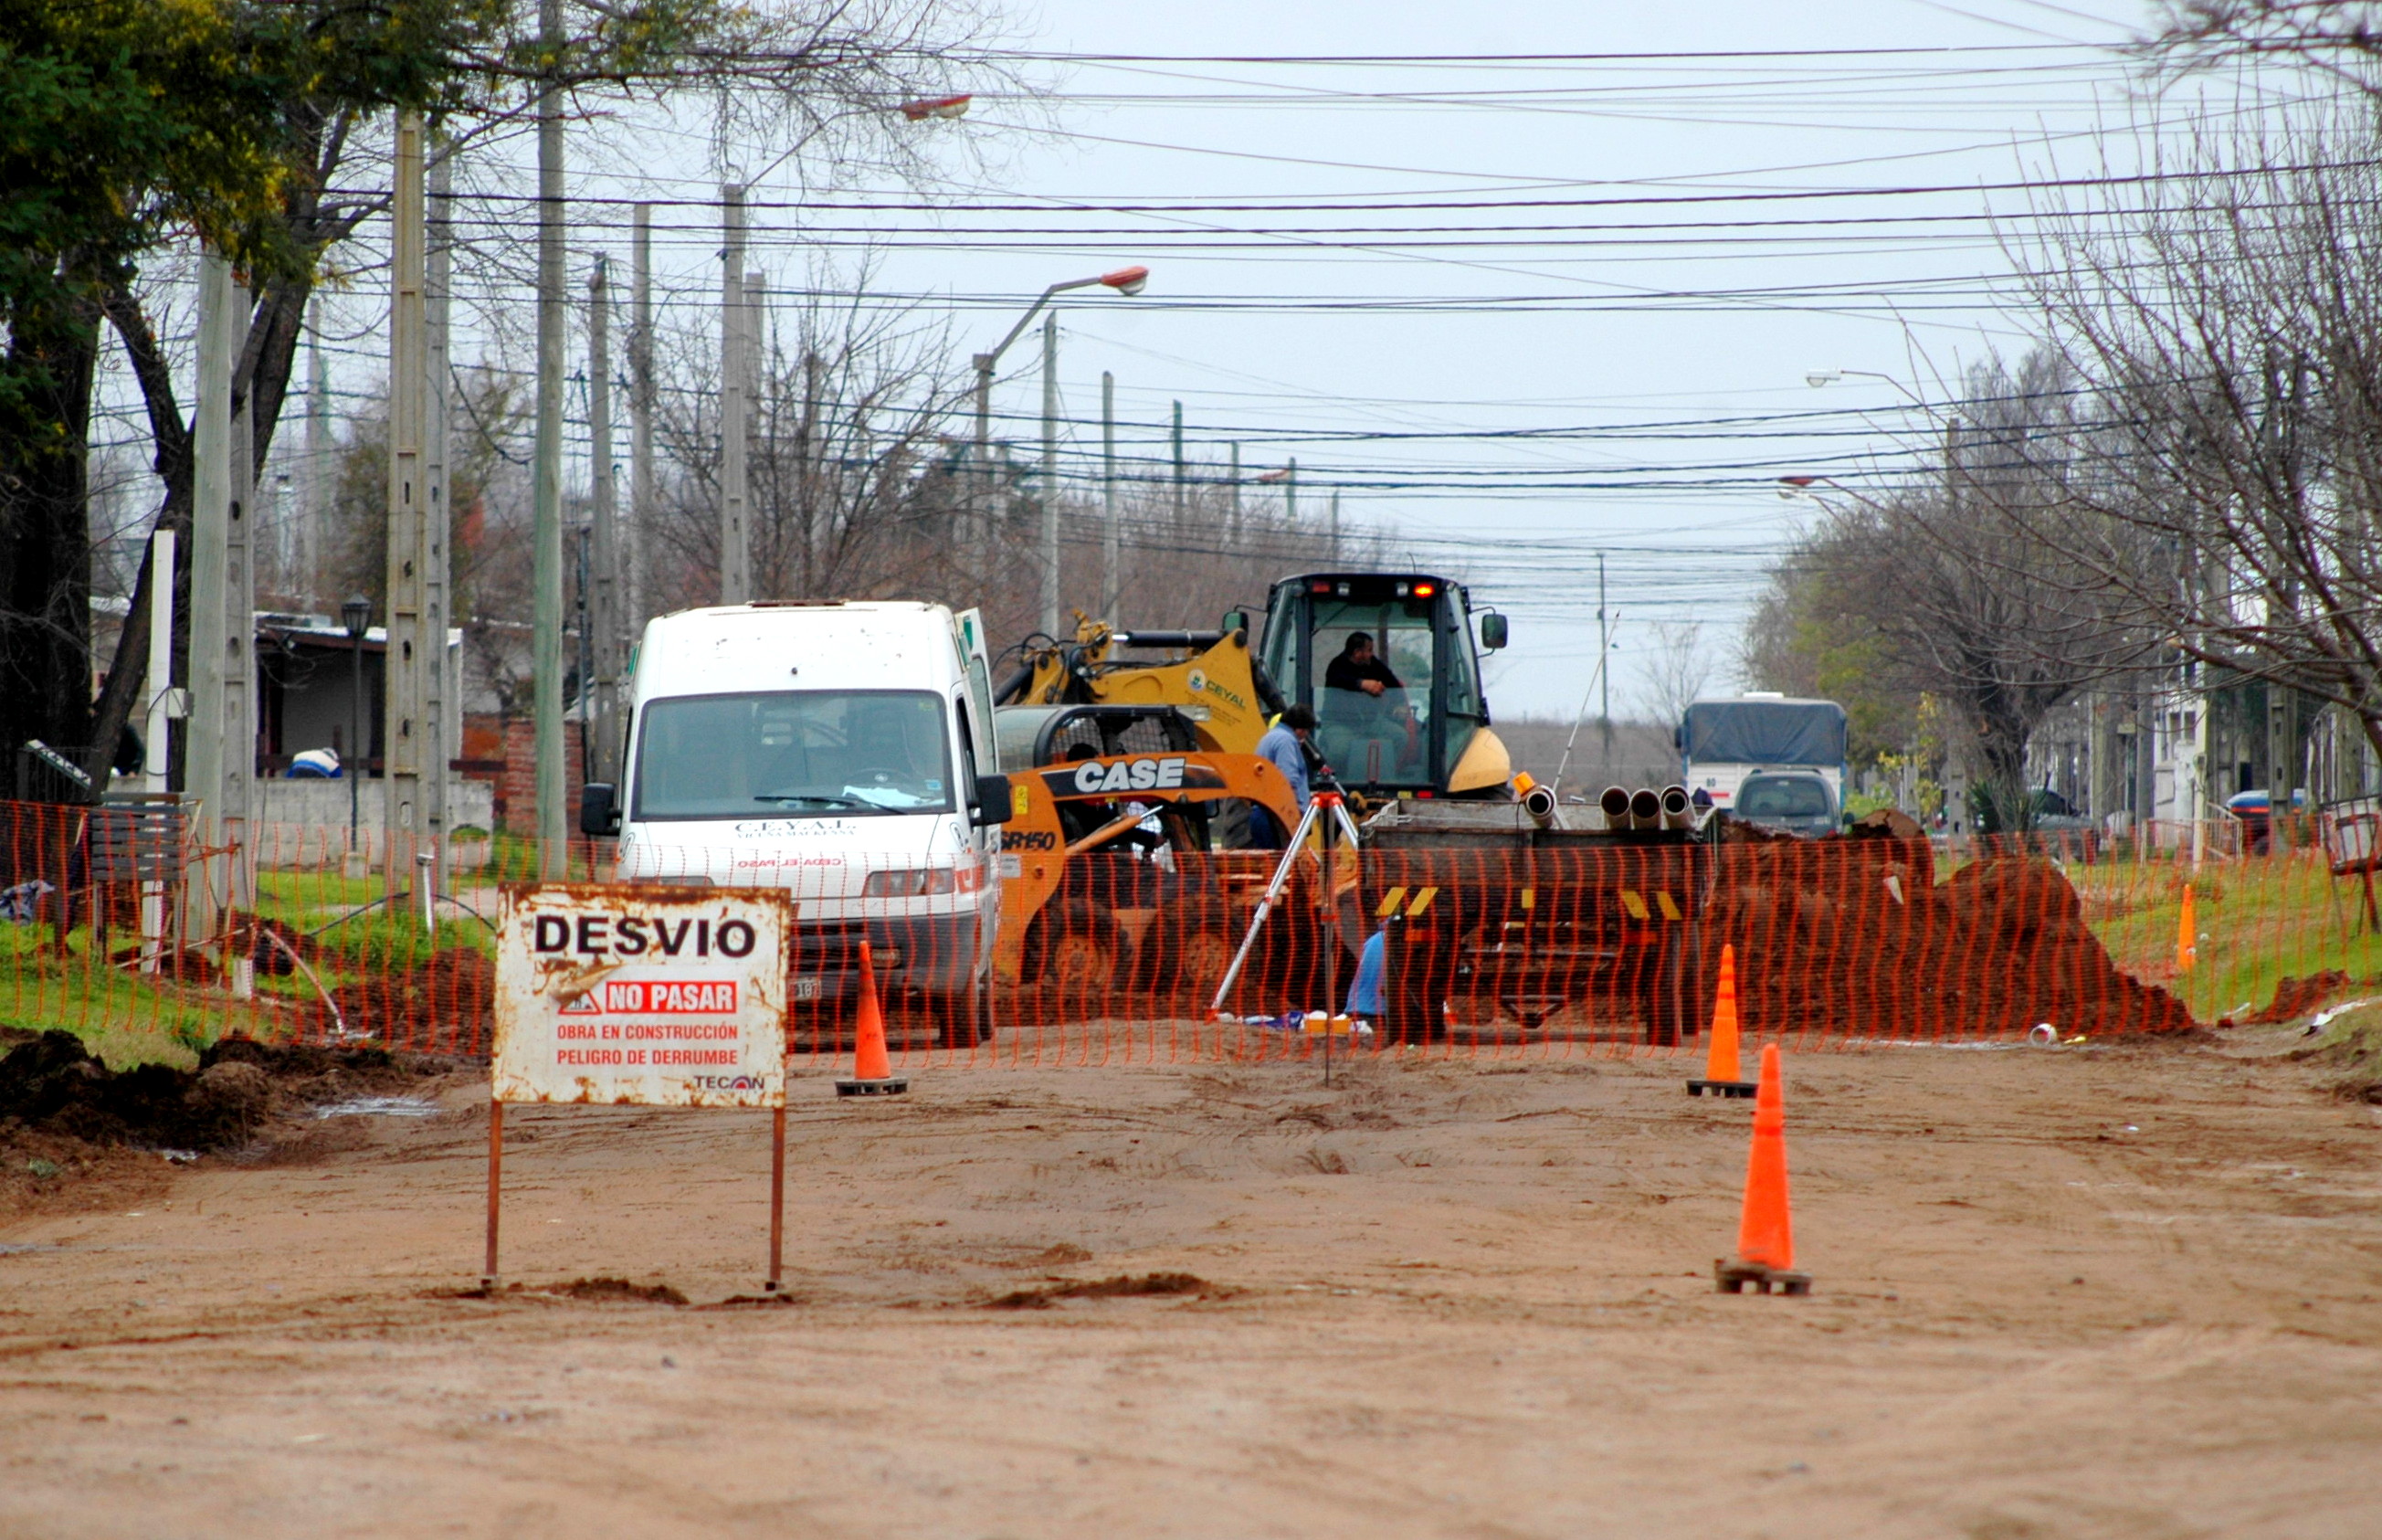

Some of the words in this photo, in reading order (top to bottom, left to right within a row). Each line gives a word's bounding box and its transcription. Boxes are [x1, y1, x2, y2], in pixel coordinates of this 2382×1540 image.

[1206, 680, 1246, 711] CEYAL
[1074, 757, 1186, 793] CASE
[535, 915, 755, 958] DESVIO
[608, 985, 643, 1011] NO
[651, 985, 733, 1011] PASAR
[557, 1025, 596, 1039] OBRA
[602, 1025, 620, 1039] EN
[626, 1021, 738, 1039] CONSTRUCCIÓN
[557, 1050, 622, 1065] PELIGRO
[627, 1050, 646, 1064] DE
[652, 1050, 737, 1065] DERRUMBE
